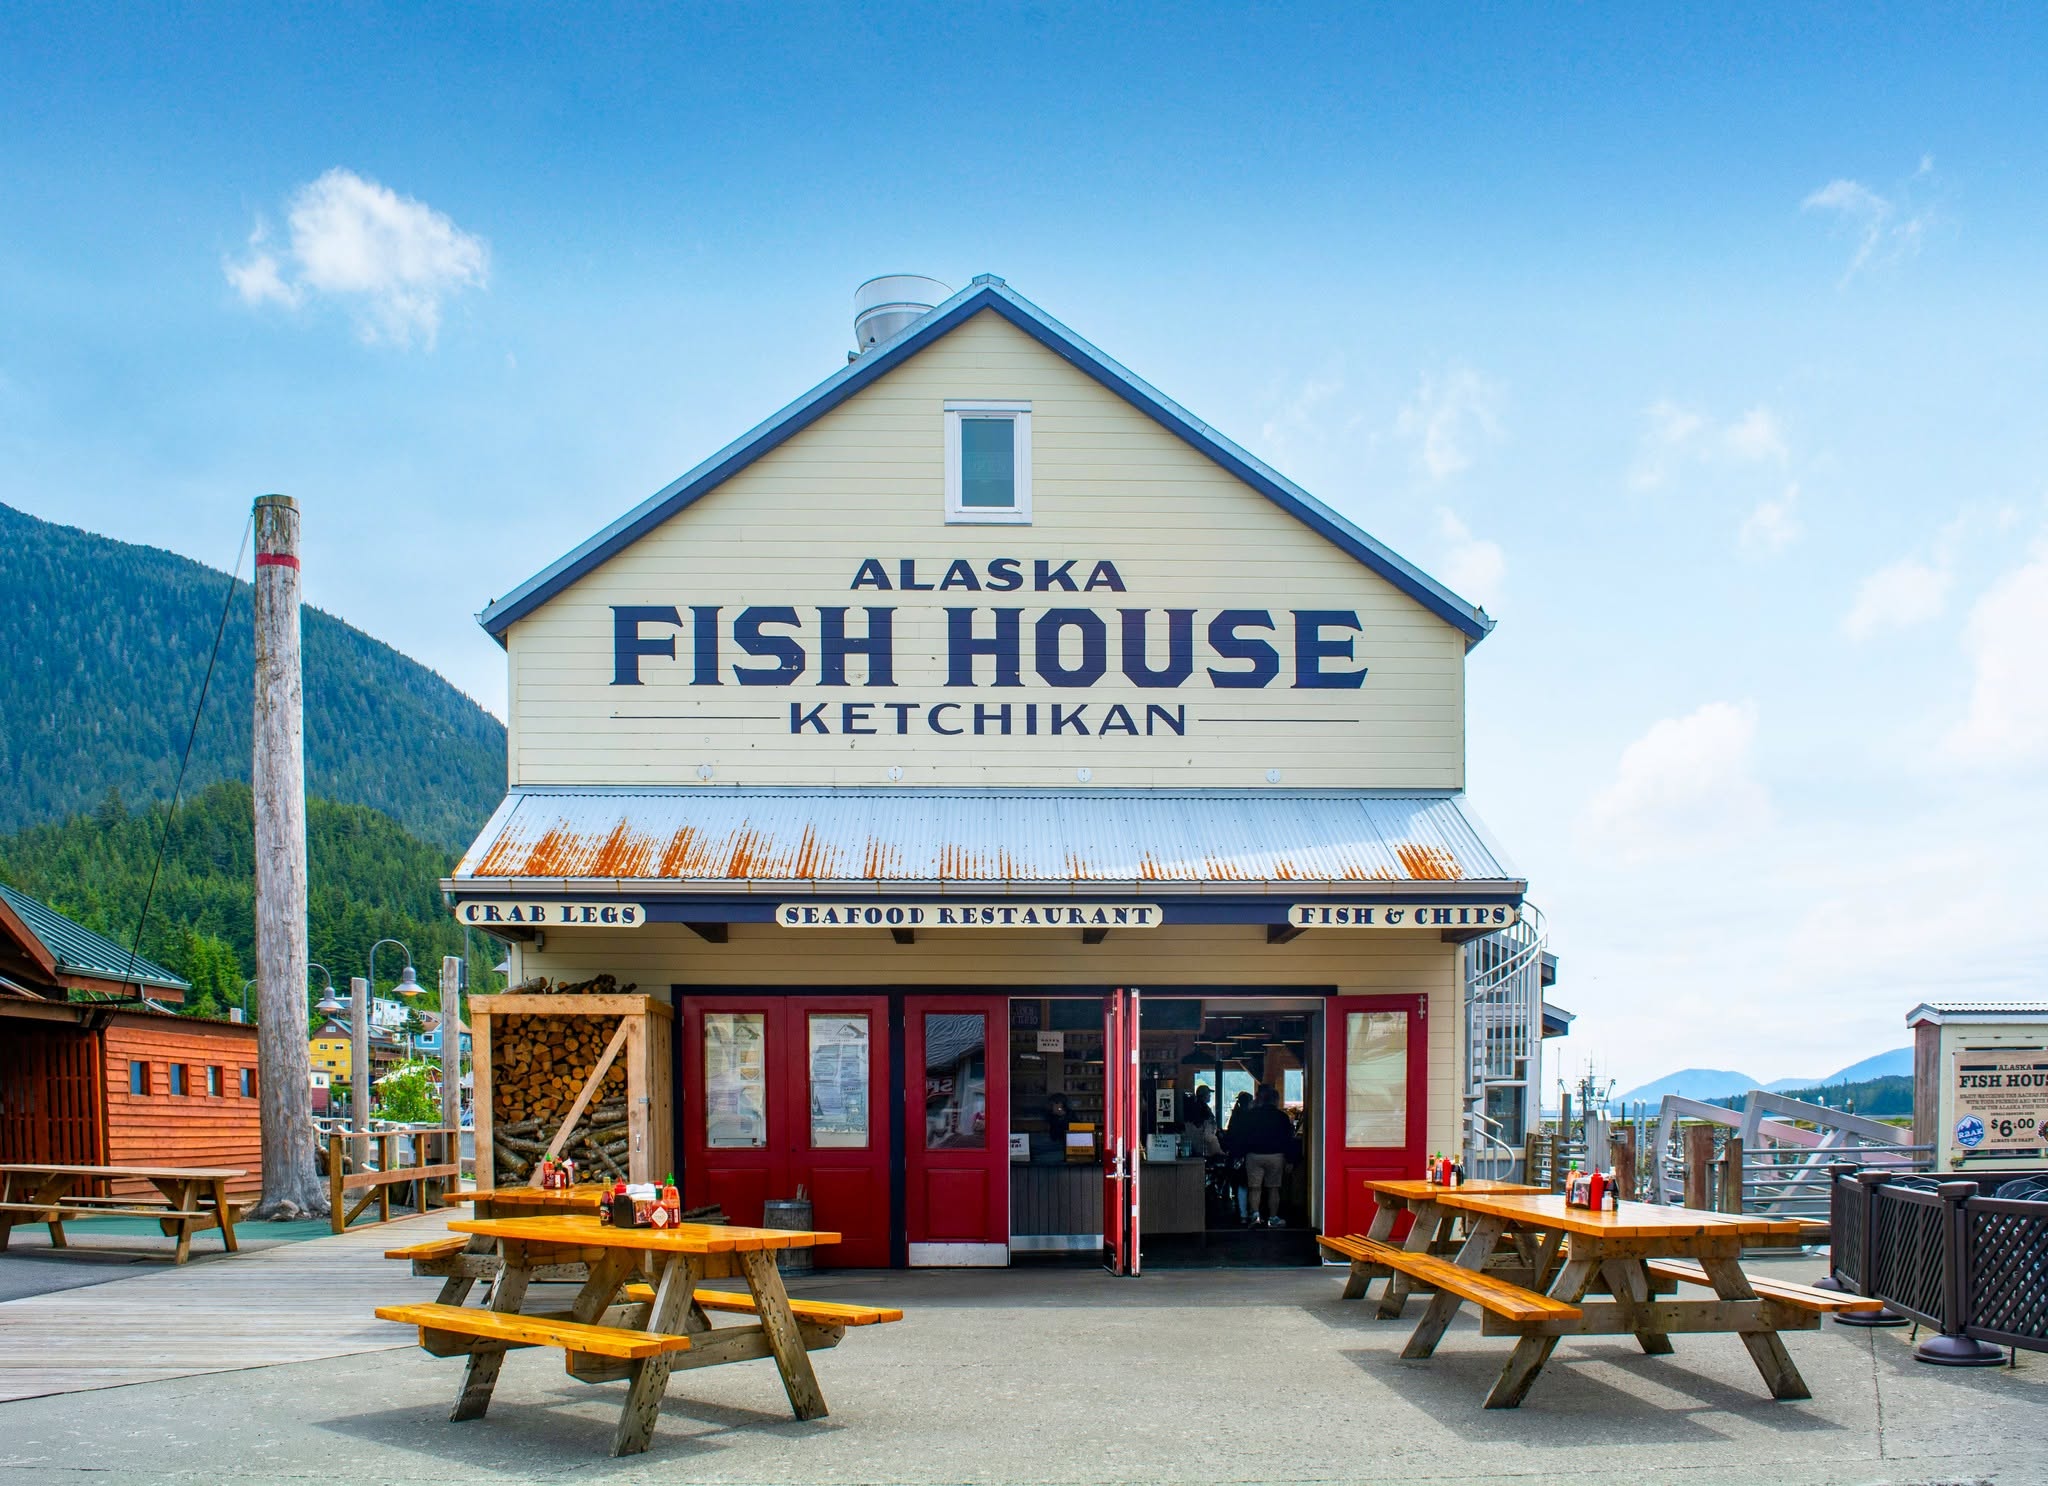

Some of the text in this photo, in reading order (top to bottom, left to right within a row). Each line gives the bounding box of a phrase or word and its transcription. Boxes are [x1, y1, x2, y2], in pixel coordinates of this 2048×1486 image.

[850, 558, 1127, 592] ALASKA
[609, 606, 1368, 689] FISH HOUSE
[791, 702, 1186, 736] KETCHIKAN
[465, 904, 636, 924] CRAB LEGS
[785, 906, 1153, 925] SEAFOOD RESTAURANT
[1299, 907, 1506, 925] FISH & CHIPS
[1959, 1075, 2002, 1088] FISH
